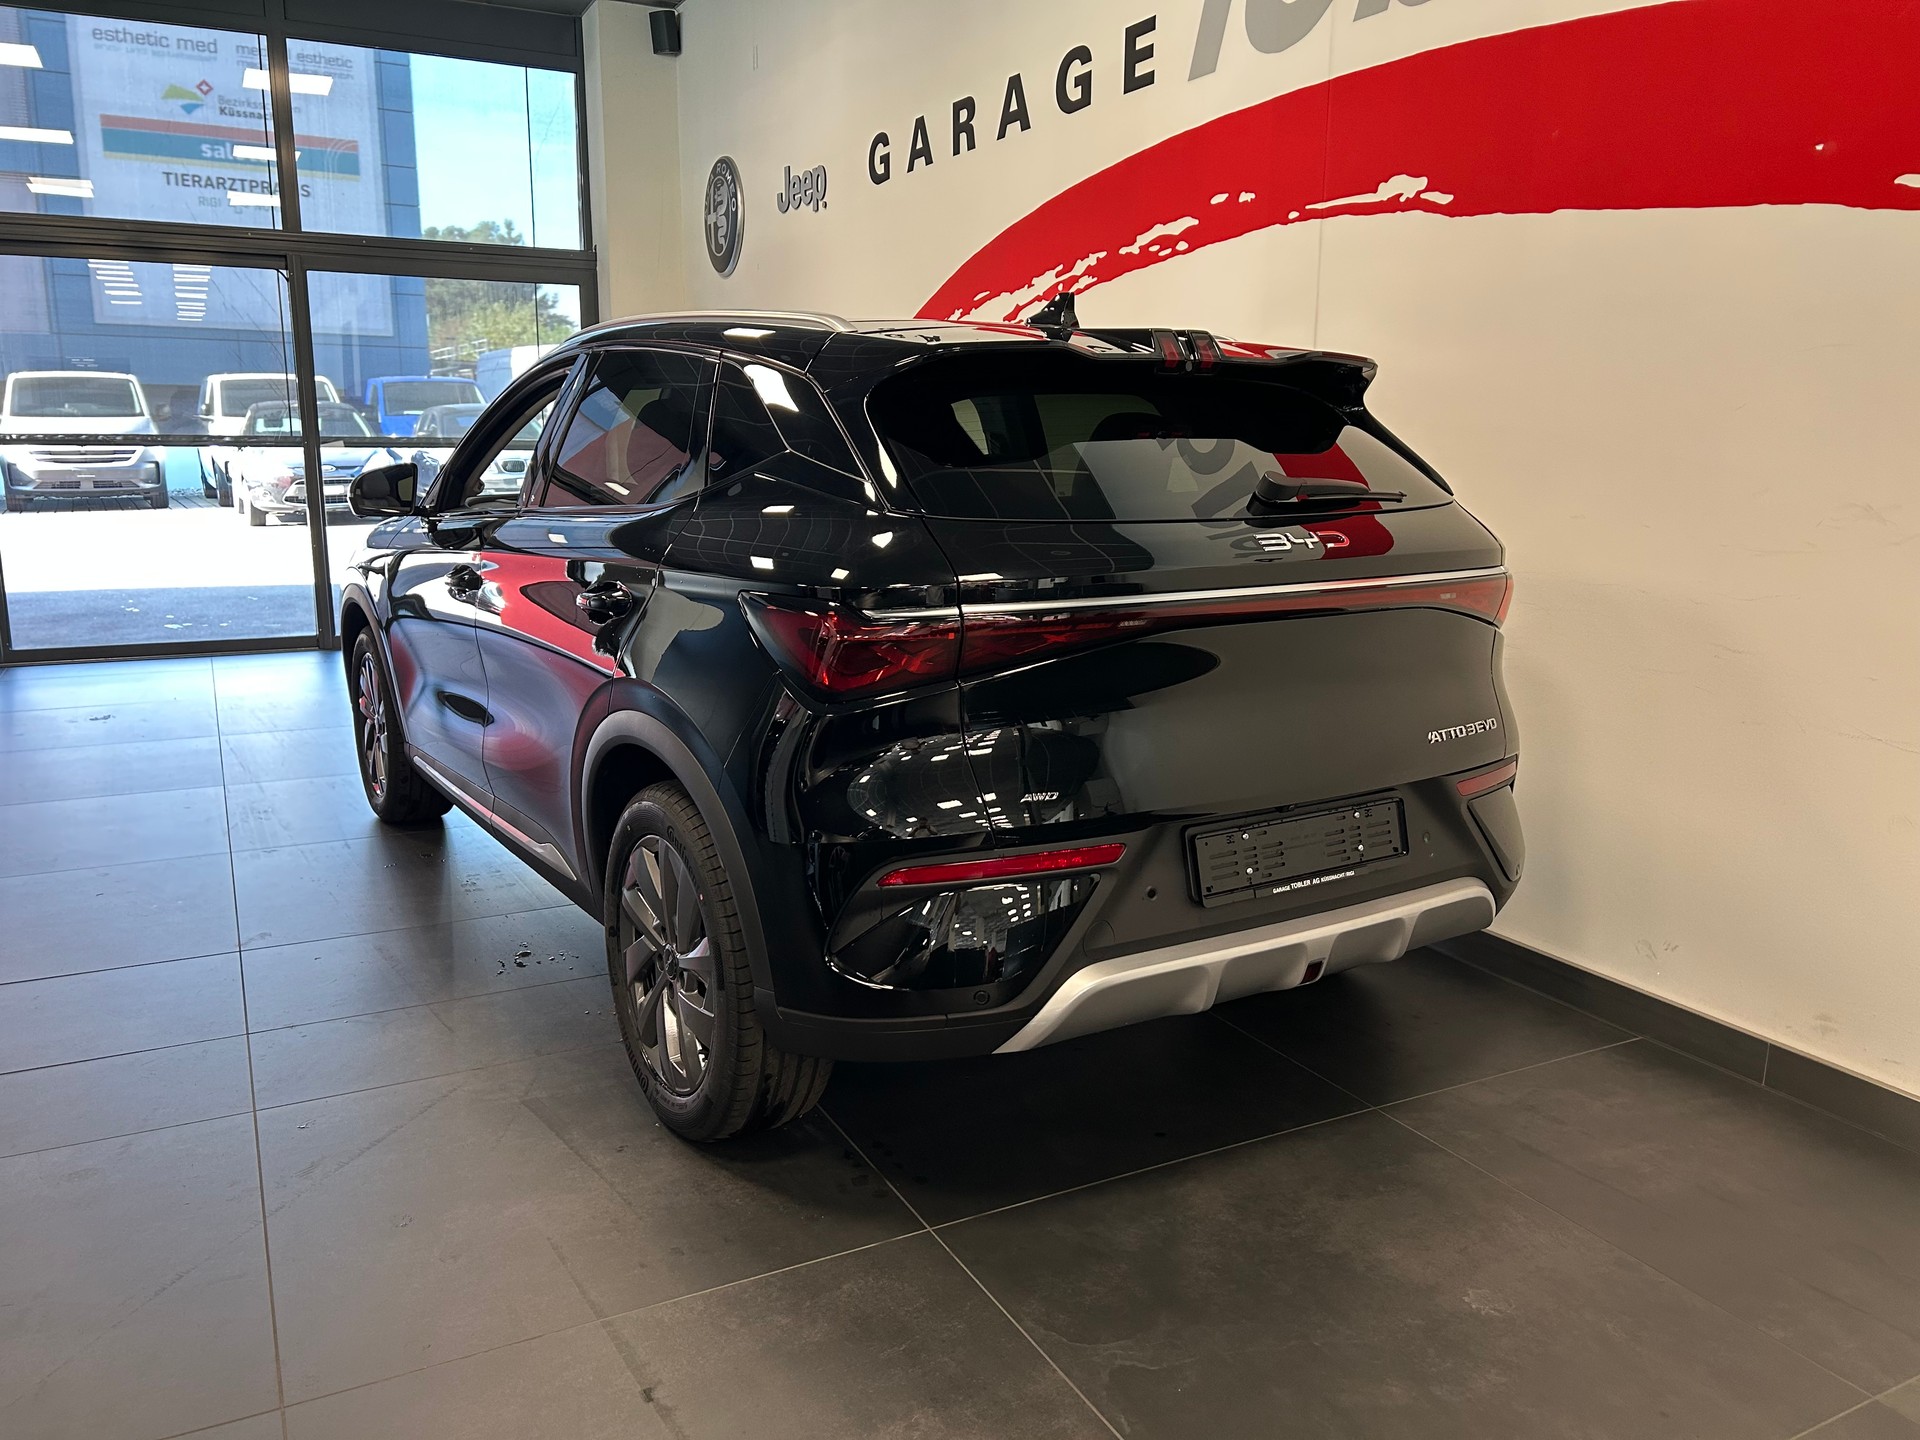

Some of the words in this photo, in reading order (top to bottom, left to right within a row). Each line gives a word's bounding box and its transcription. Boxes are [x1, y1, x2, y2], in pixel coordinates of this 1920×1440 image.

[92, 27, 171, 48] esthetic
[176, 38, 218, 54] med
[296, 49, 353, 69] esthetic
[868, 15, 1157, 185] GARAGE
[777, 164, 827, 214] Jeep
[1253, 530, 1350, 552] BYD
[1020, 791, 1059, 803] AWD
[1273, 885, 1291, 893] GARAGE
[1291, 880, 1311, 889] TOBLER
[1312, 877, 1320, 885] AG
